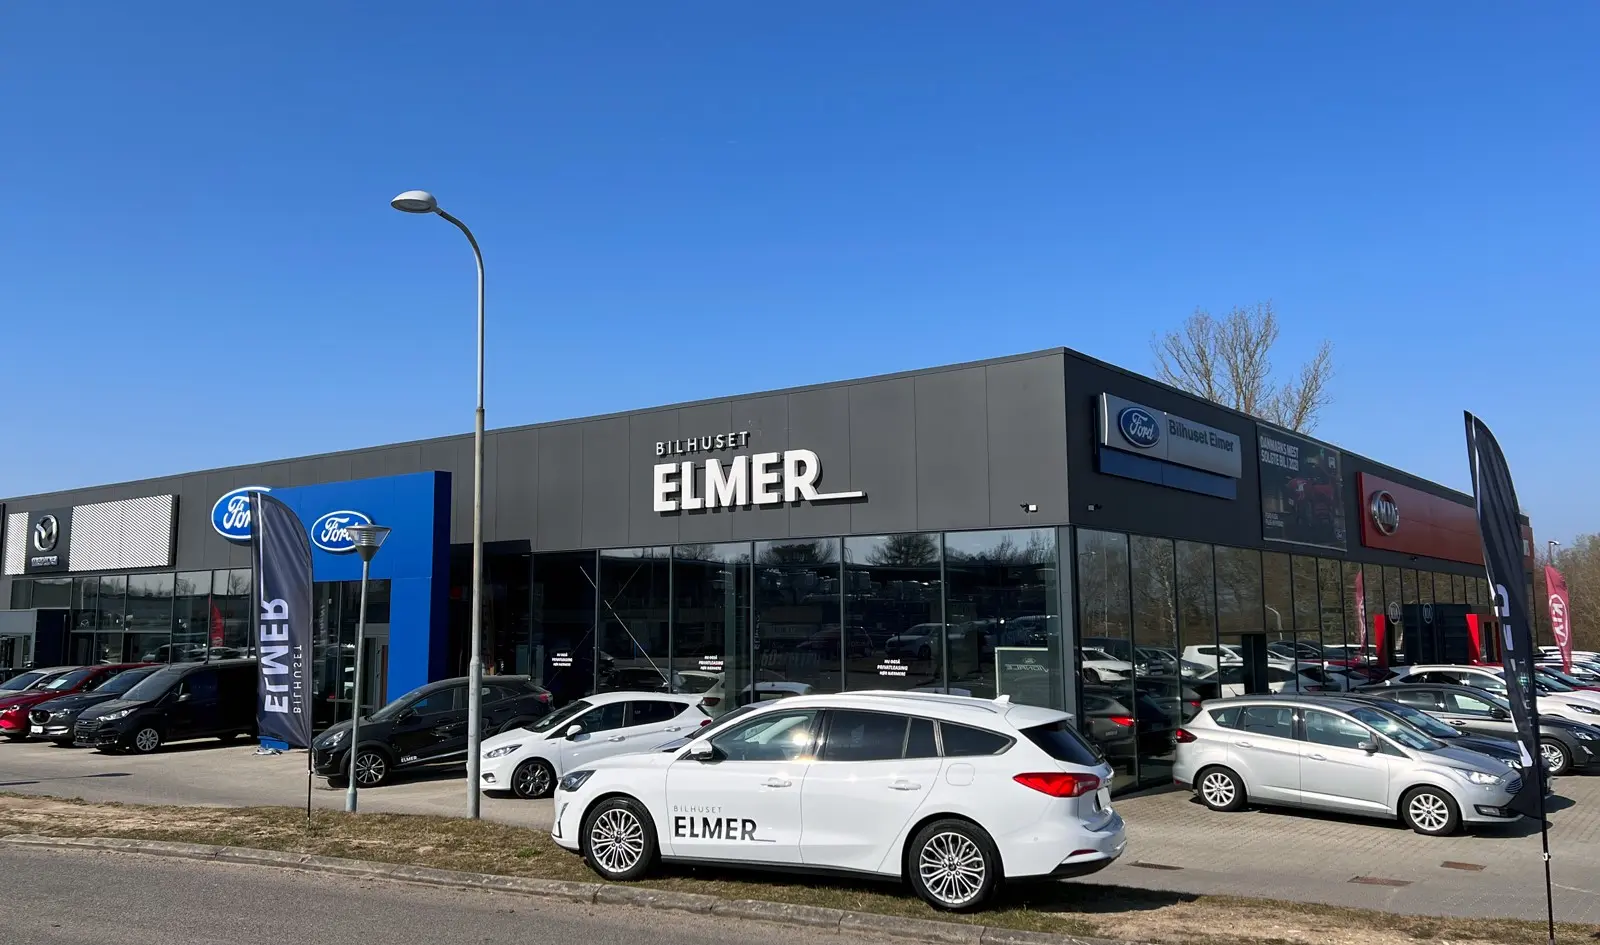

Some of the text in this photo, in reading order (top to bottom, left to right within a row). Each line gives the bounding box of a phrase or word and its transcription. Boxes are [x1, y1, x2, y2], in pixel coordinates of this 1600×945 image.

[1129, 412, 1155, 441] Ford
[1168, 418, 1234, 453] Bilhuset Elmer
[655, 431, 750, 456] BILHUSET
[653, 448, 865, 512] ELMER
[223, 495, 251, 530] For
[400, 755, 418, 763] ELMER
[673, 805, 722, 814] BILHUSET
[674, 815, 777, 843] ELMER
